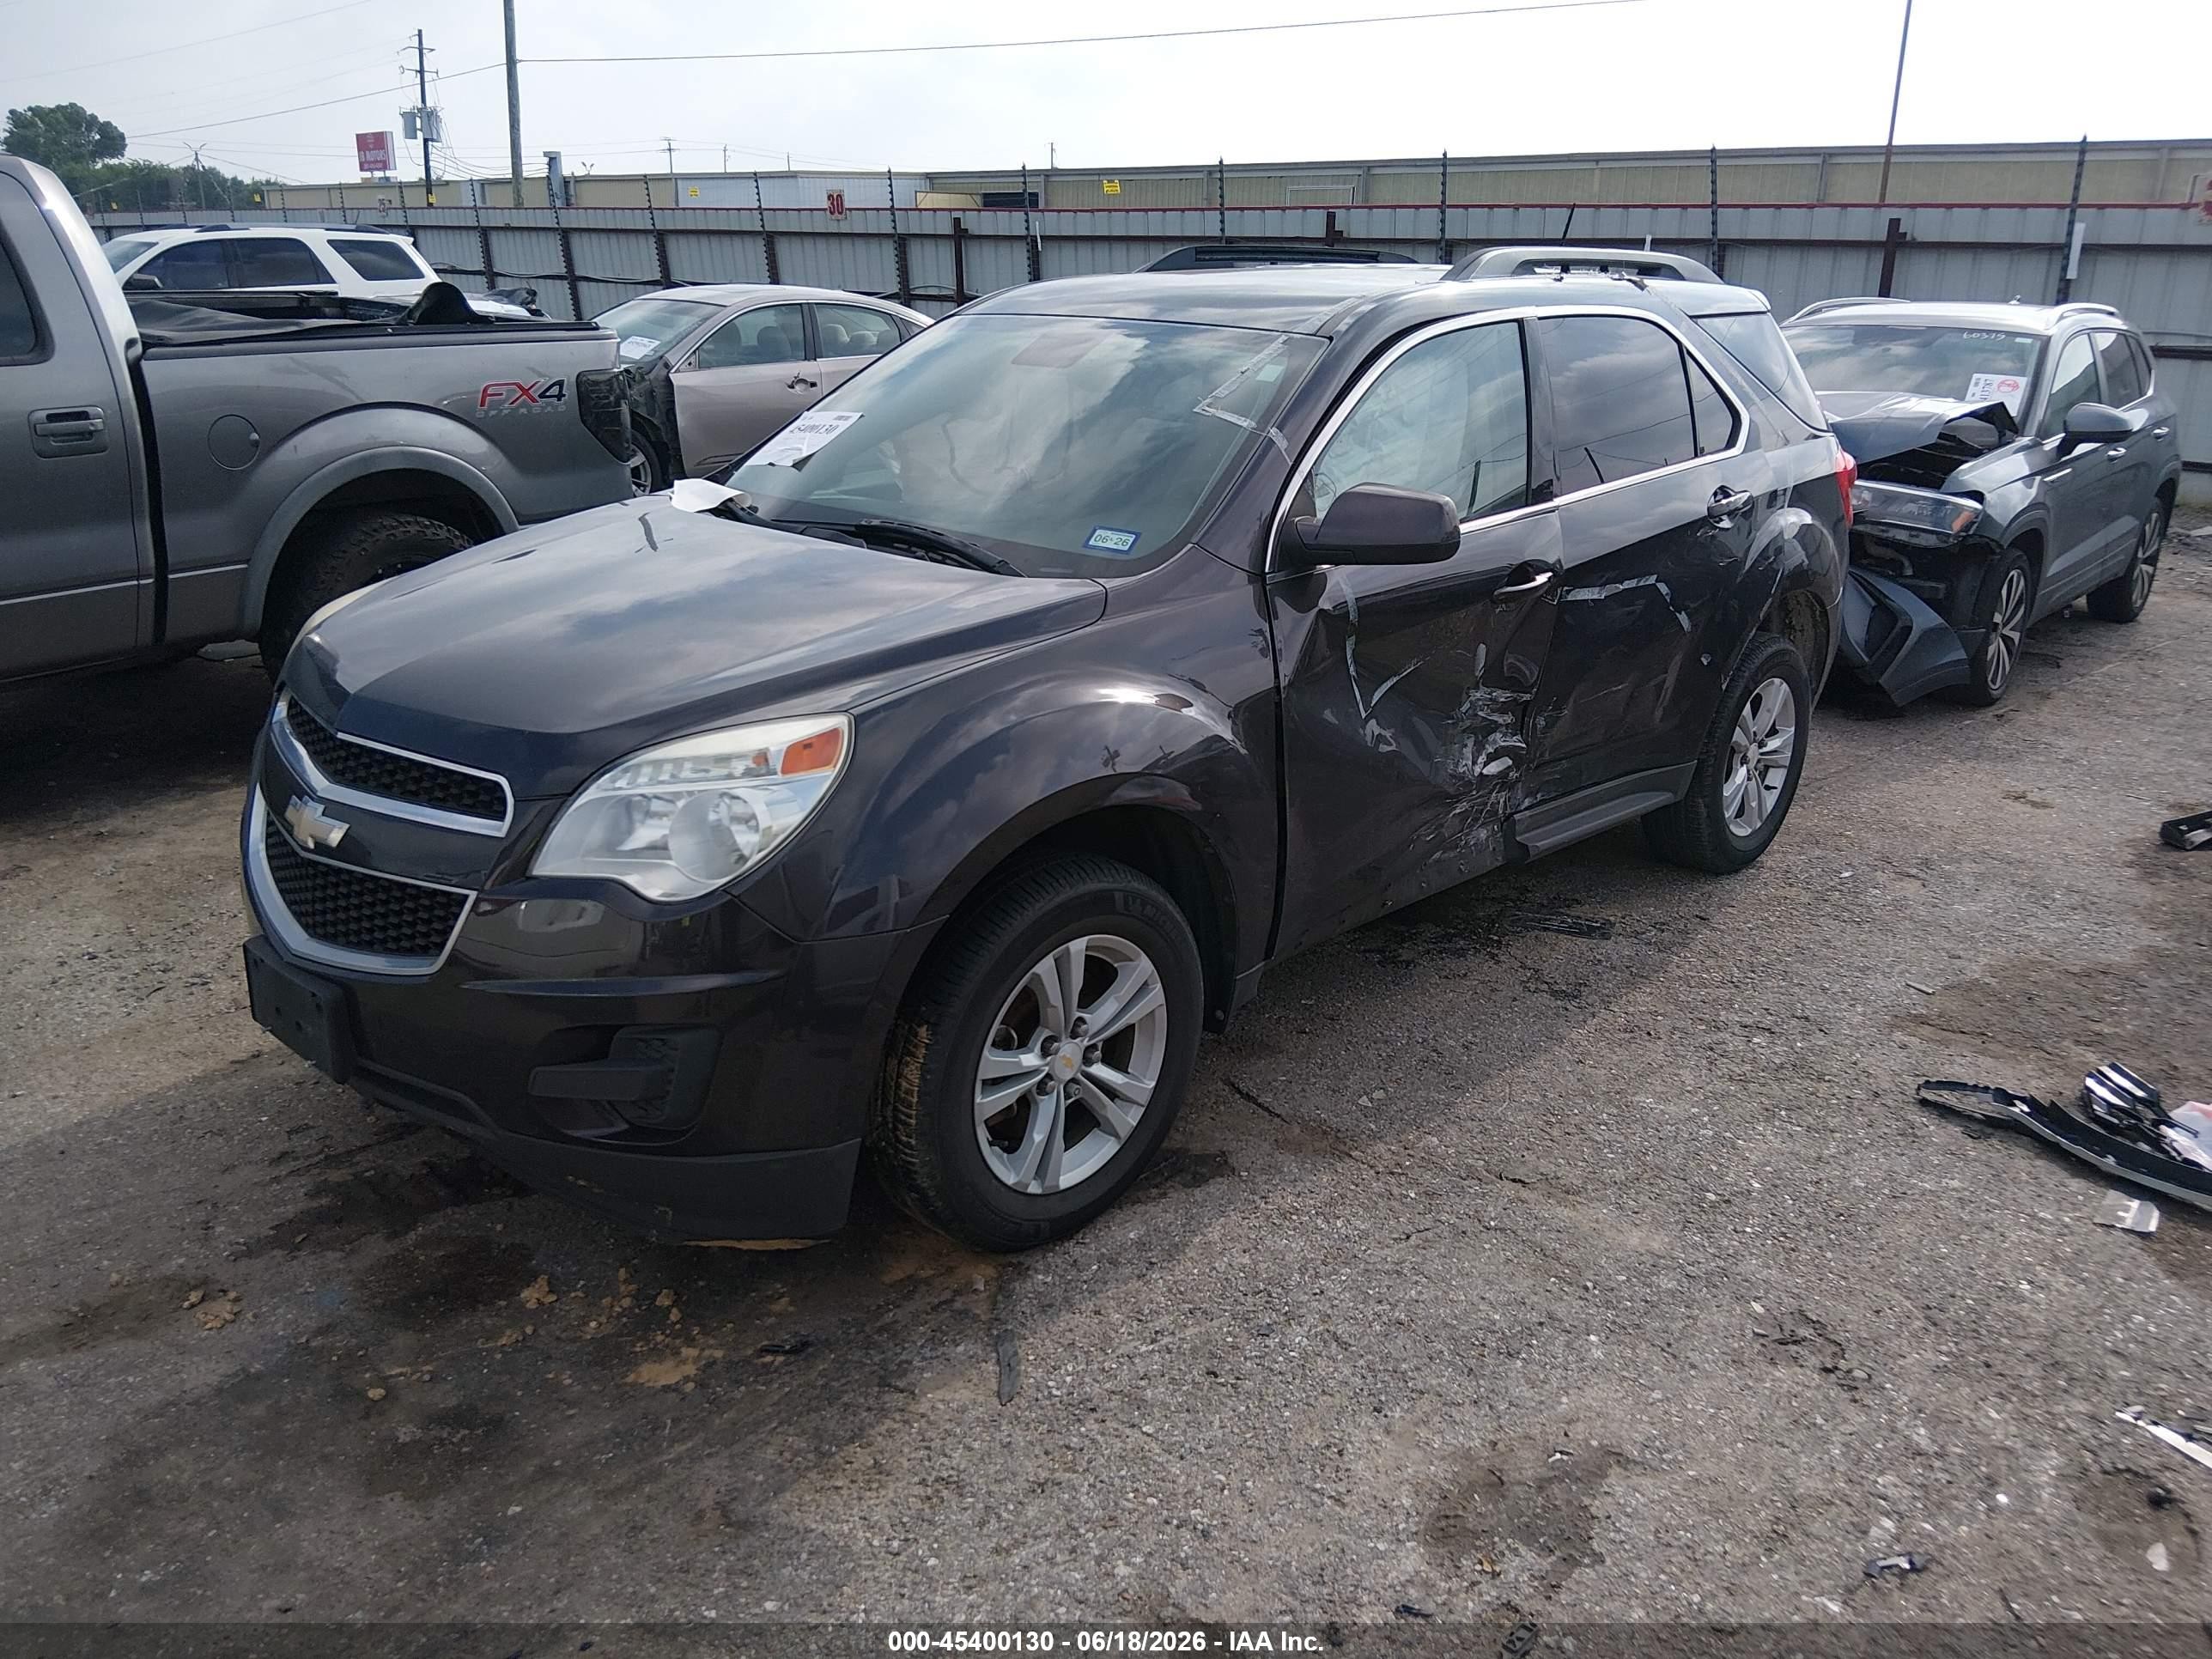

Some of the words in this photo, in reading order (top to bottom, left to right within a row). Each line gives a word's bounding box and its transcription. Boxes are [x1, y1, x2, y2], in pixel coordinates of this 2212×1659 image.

[827, 193, 844, 216] 30
[478, 378, 567, 408] FX4
[476, 409, 512, 418] OFF
[519, 405, 567, 414] ROAD
[1094, 534, 1109, 544] 06
[1114, 537, 1131, 547] 26
